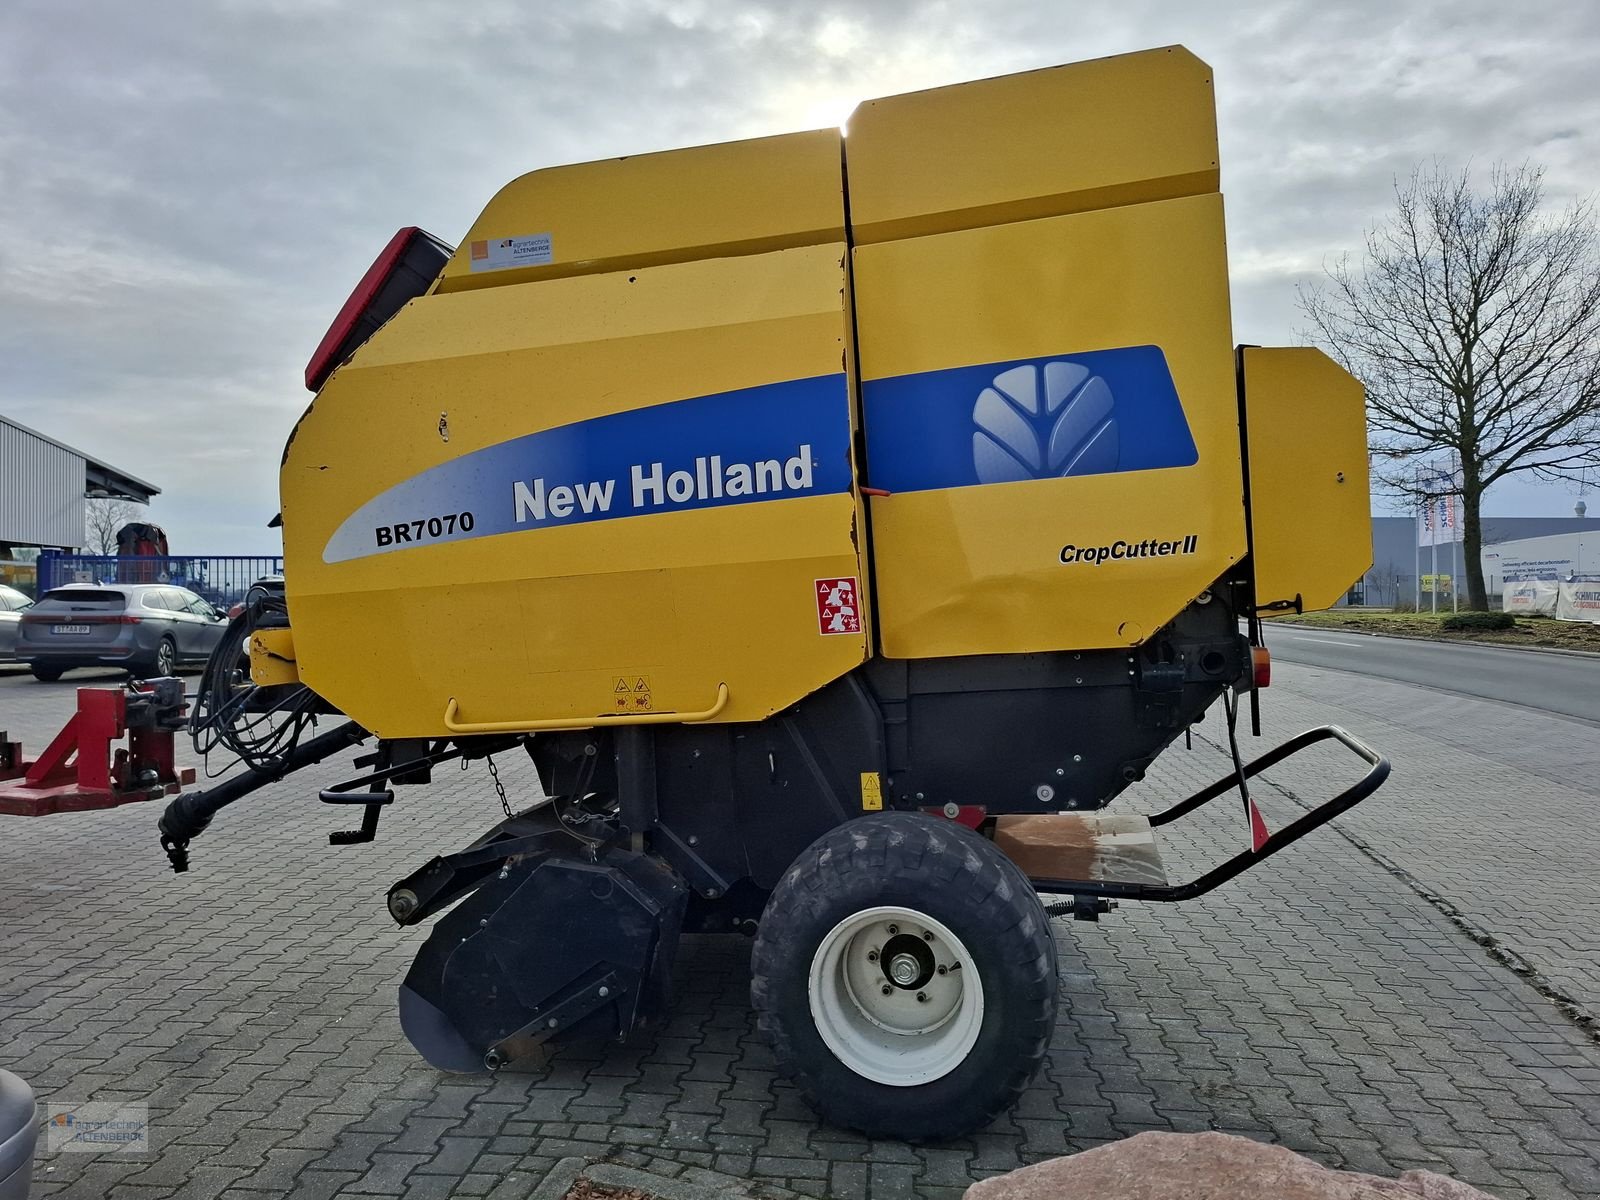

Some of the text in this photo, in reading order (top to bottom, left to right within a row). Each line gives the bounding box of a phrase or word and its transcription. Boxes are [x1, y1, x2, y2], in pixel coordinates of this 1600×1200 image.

[513, 245, 550, 254] ALTENBERGE
[513, 443, 814, 523] New Holland
[375, 511, 475, 547] BR7070
